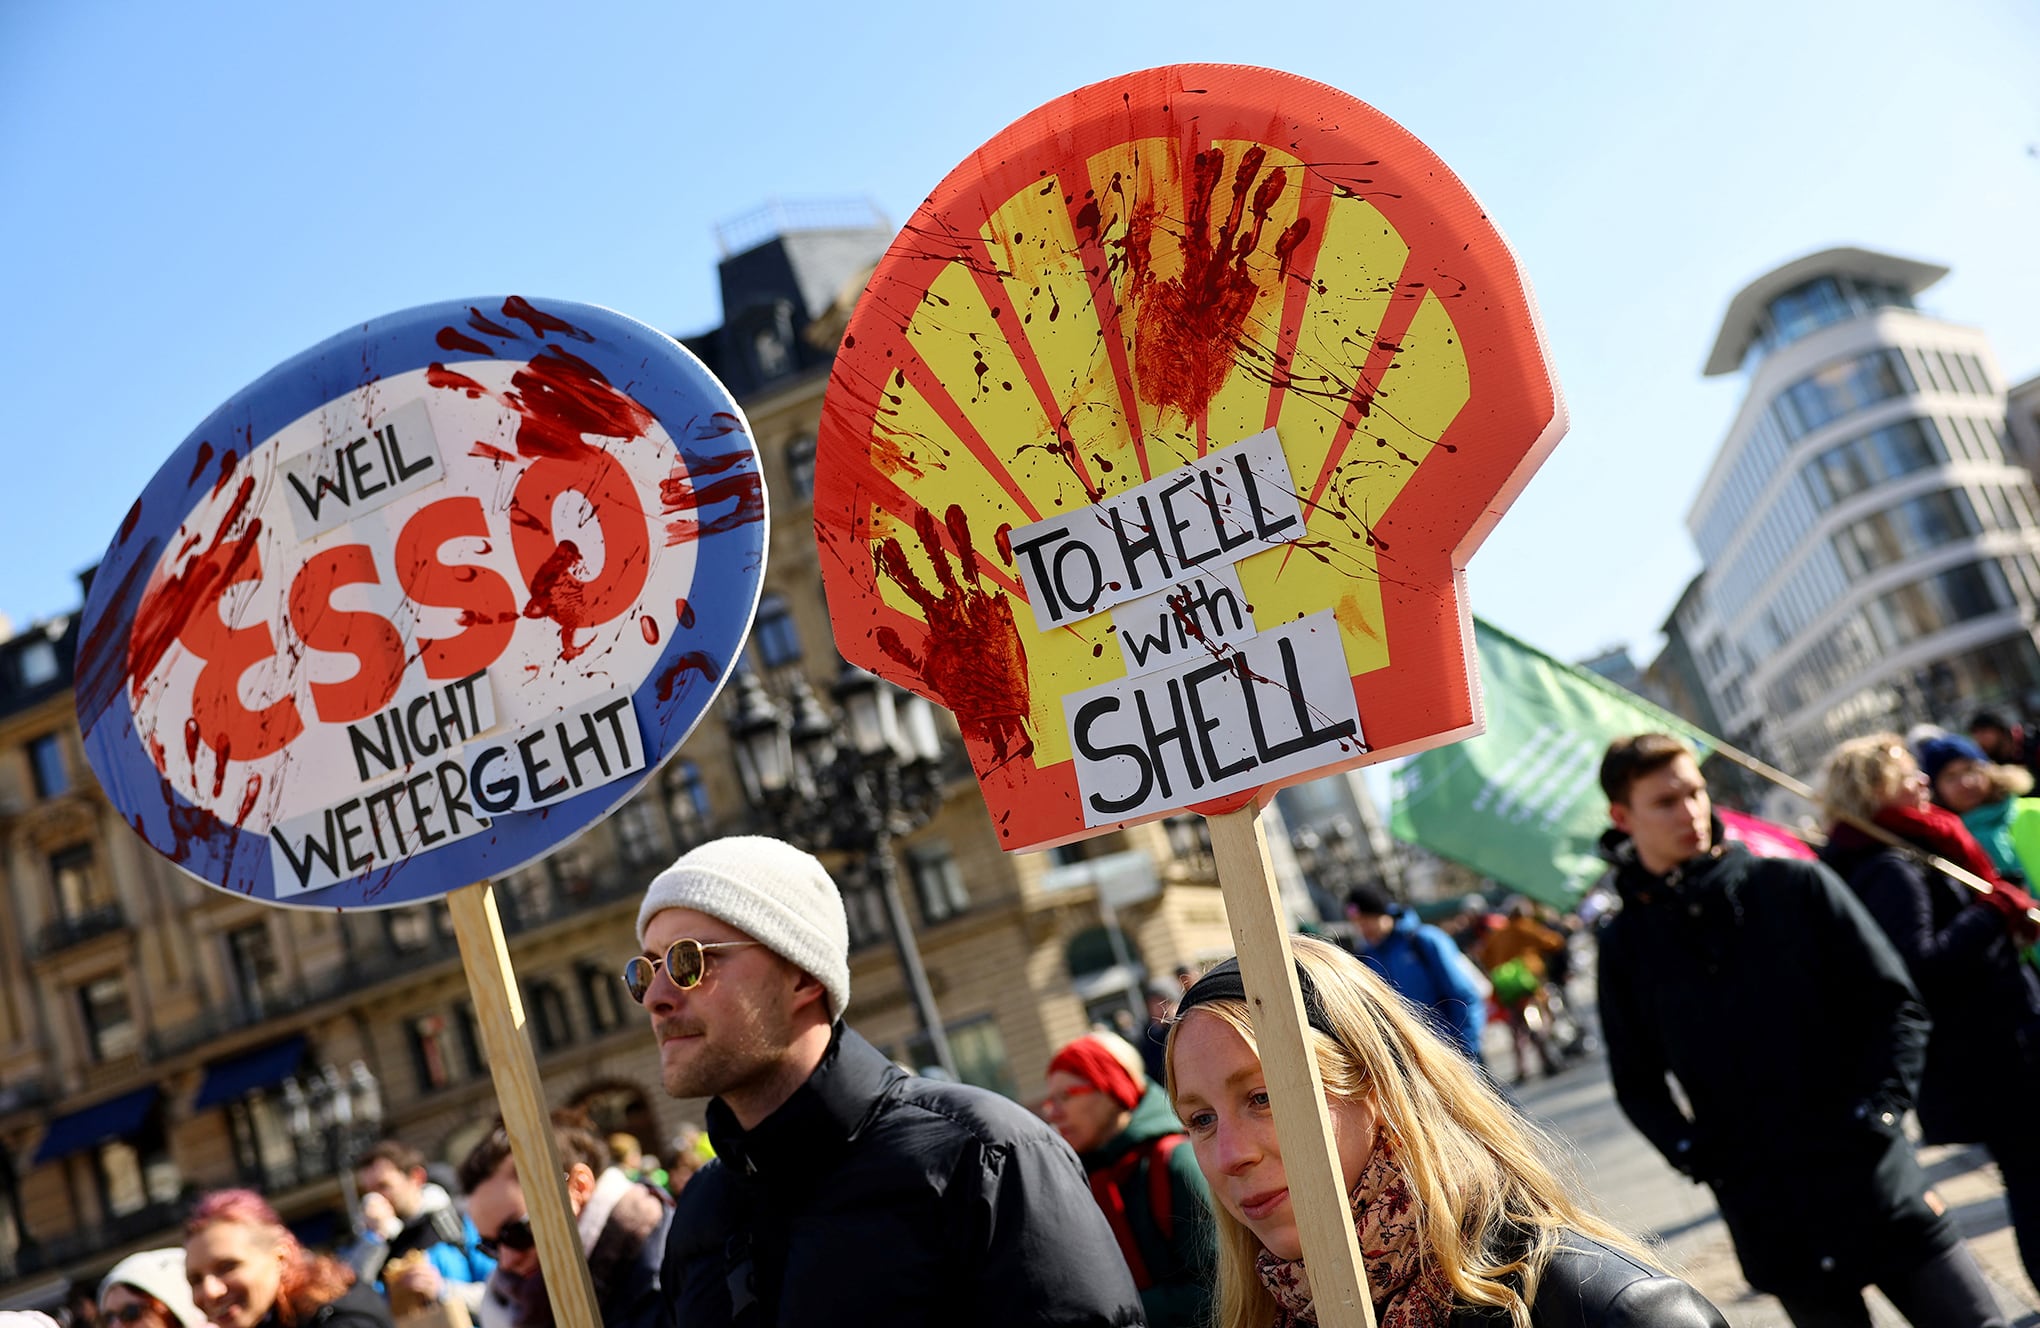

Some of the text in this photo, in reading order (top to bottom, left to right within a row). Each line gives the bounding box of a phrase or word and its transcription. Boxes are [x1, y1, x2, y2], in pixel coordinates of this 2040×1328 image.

[286, 423, 433, 520] WEIL
[1109, 453, 1297, 590] HELL
[1122, 579, 1243, 667] with
[347, 671, 488, 781] NICHT
[1073, 637, 1356, 813] SHELL
[270, 697, 632, 888] WEITERGEHT
